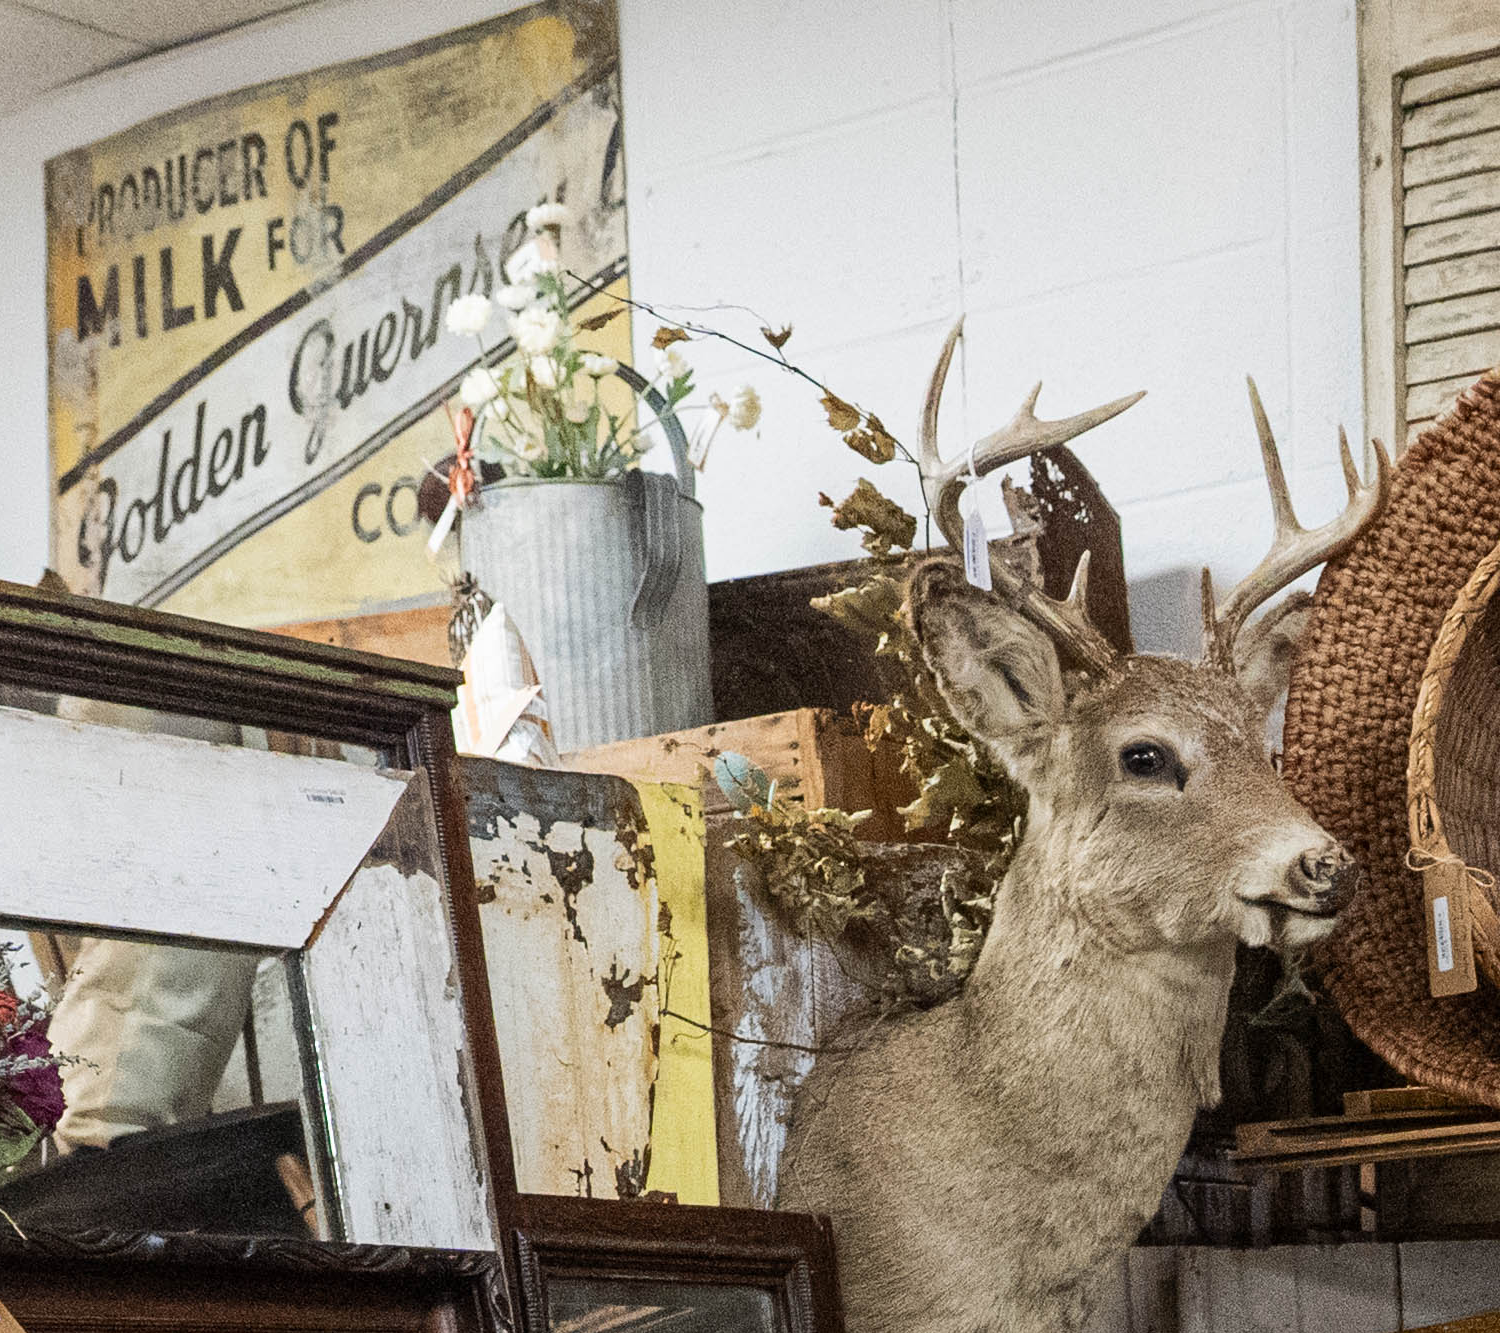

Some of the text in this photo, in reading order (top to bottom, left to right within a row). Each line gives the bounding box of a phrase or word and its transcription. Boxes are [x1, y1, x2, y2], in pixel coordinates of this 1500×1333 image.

[285, 113, 340, 190] OF
[76, 204, 346, 343] MILK FOR
[76, 190, 566, 592] Golden Guernse
